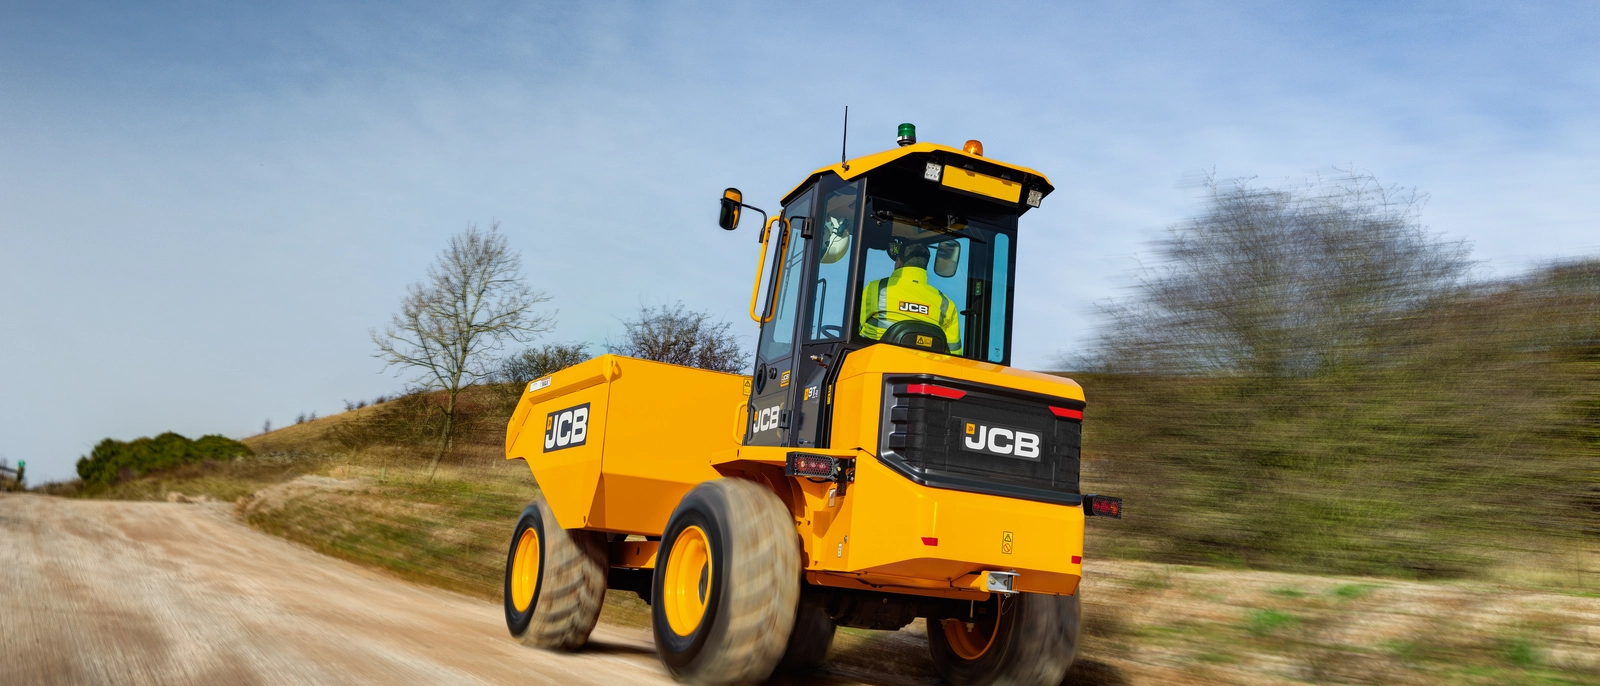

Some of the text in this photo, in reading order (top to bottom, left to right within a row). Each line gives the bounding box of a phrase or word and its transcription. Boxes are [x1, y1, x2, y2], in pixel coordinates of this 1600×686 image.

[899, 302, 929, 315] JCB
[545, 407, 588, 449] JCB
[753, 405, 780, 433] JCB
[965, 425, 1040, 458] JCB
